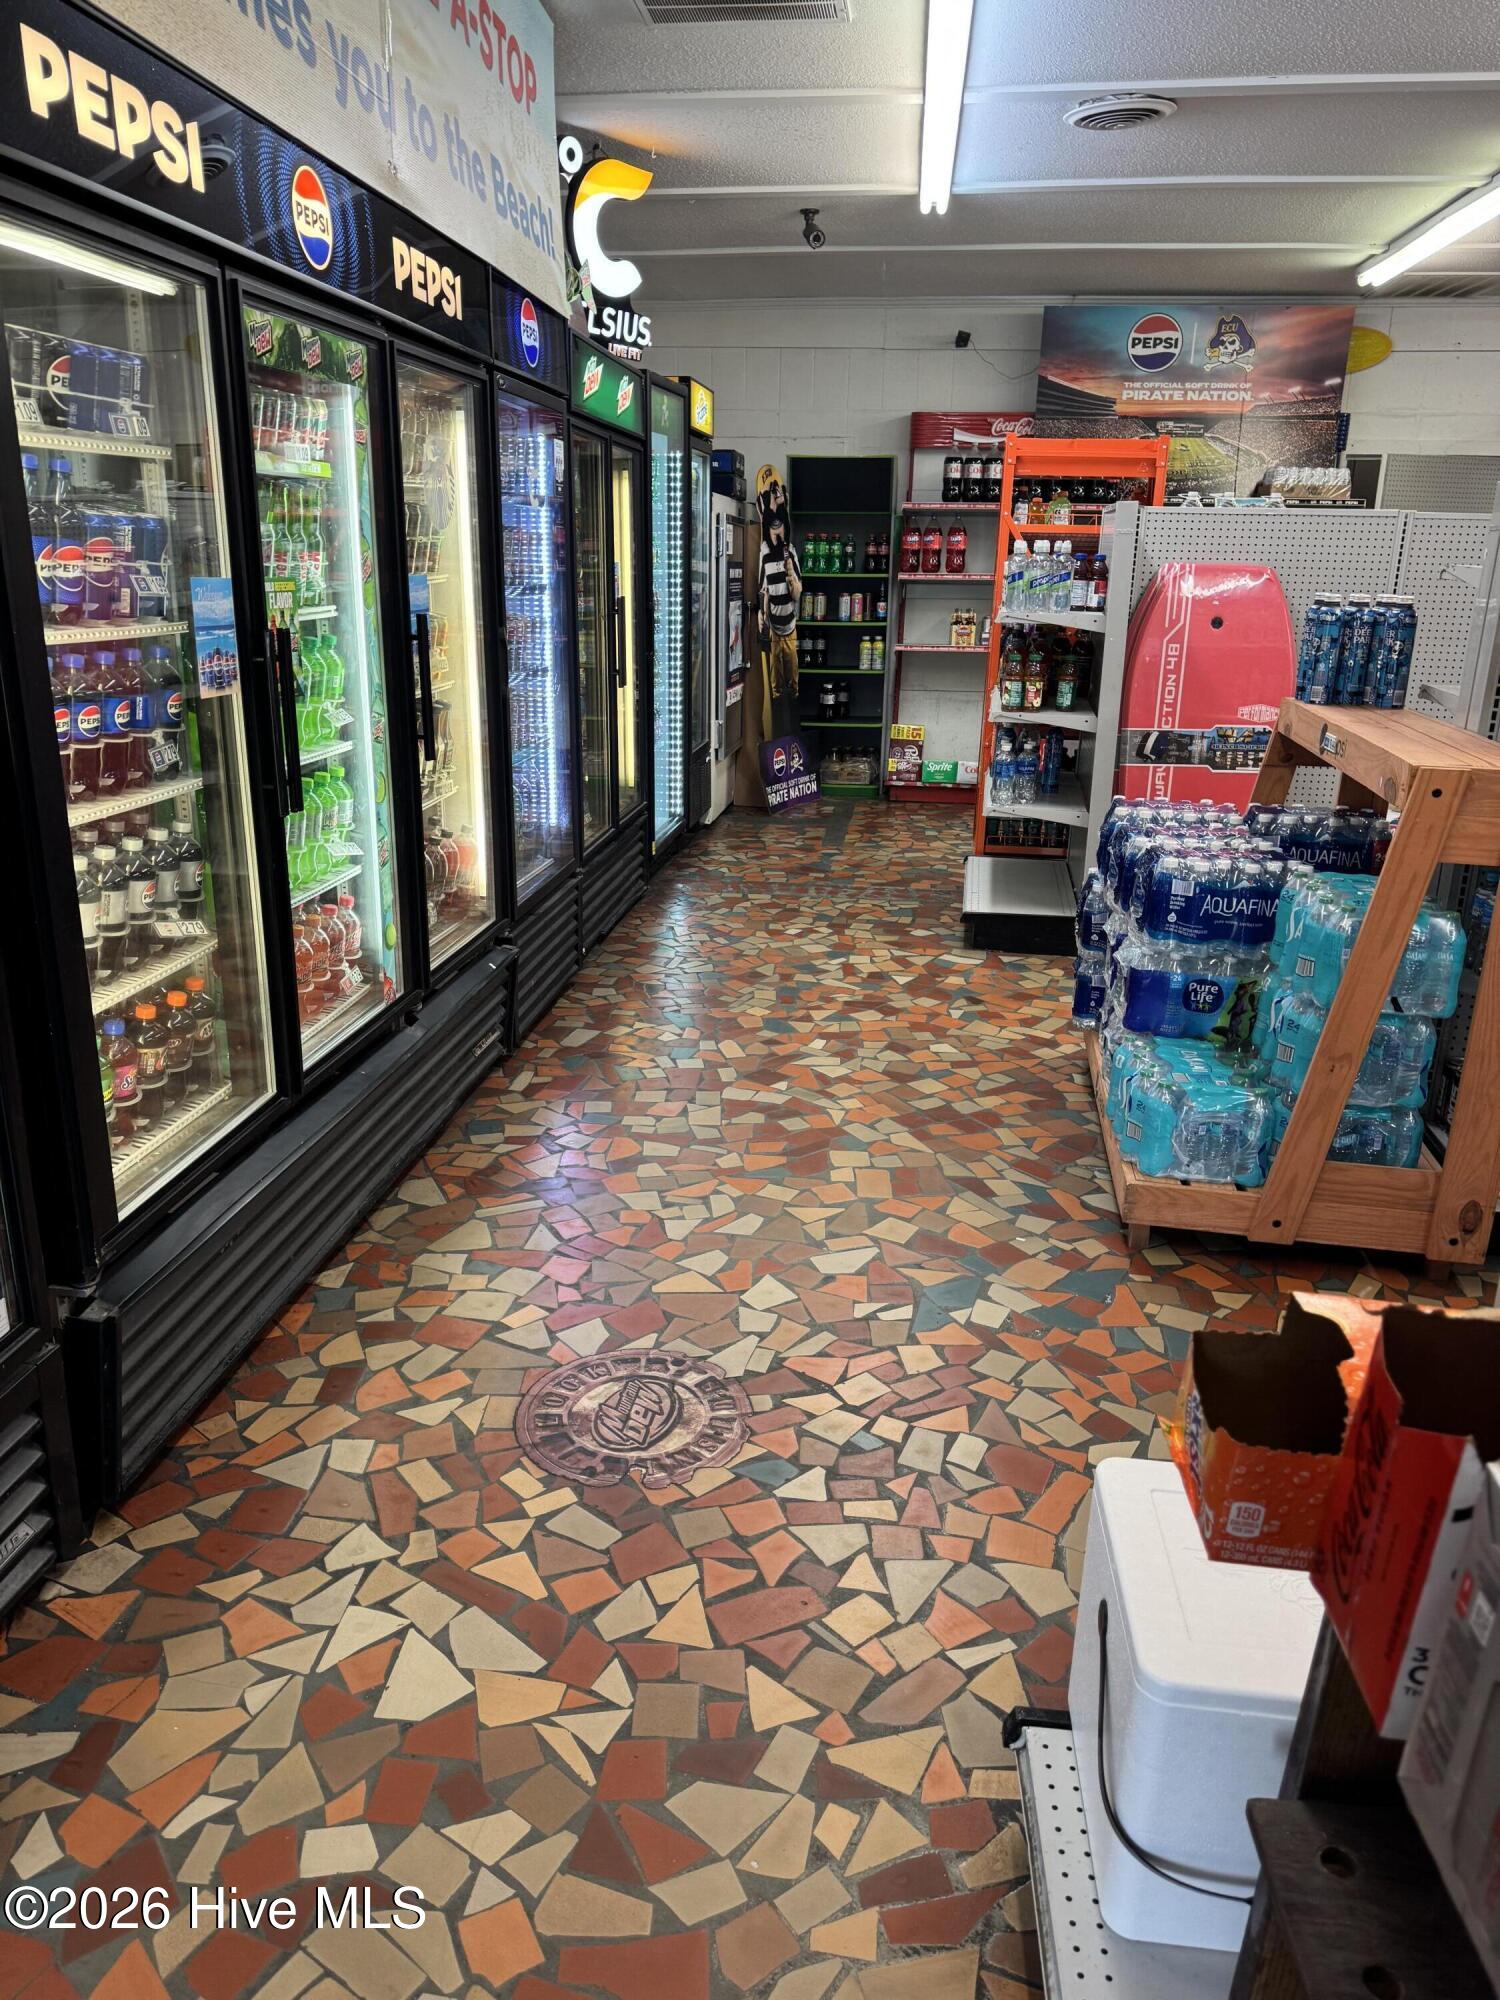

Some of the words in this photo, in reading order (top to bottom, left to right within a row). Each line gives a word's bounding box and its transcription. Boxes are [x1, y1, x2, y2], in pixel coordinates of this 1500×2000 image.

[20, 22, 206, 193] PEPSI
[325, 18, 395, 134] you
[404, 76, 438, 162] to
[444, 111, 487, 202] the
[489, 153, 556, 261] Beach!
[296, 200, 330, 236] PEPSI
[392, 236, 463, 321] PEPSI
[522, 321, 538, 342] PEPSI
[1221, 323, 1238, 333] ECU
[1131, 337, 1179, 350] PEPSI
[1121, 390, 1184, 401] PIRATE
[1186, 390, 1254, 401] NATION.
[1167, 643, 1180, 669] 48
[1162, 674, 1177, 728] CTION
[80, 717, 100, 726] PEPS
[927, 762, 953, 772] Sprite
[789, 781, 817, 800] NATION
[1290, 846, 1363, 869] AQUAFINA
[1200, 894, 1279, 917] AQUAFINA
[1189, 982, 1219, 994] Pure
[1190, 992, 1214, 1003] Life
[1236, 1506, 1262, 1521] 150
